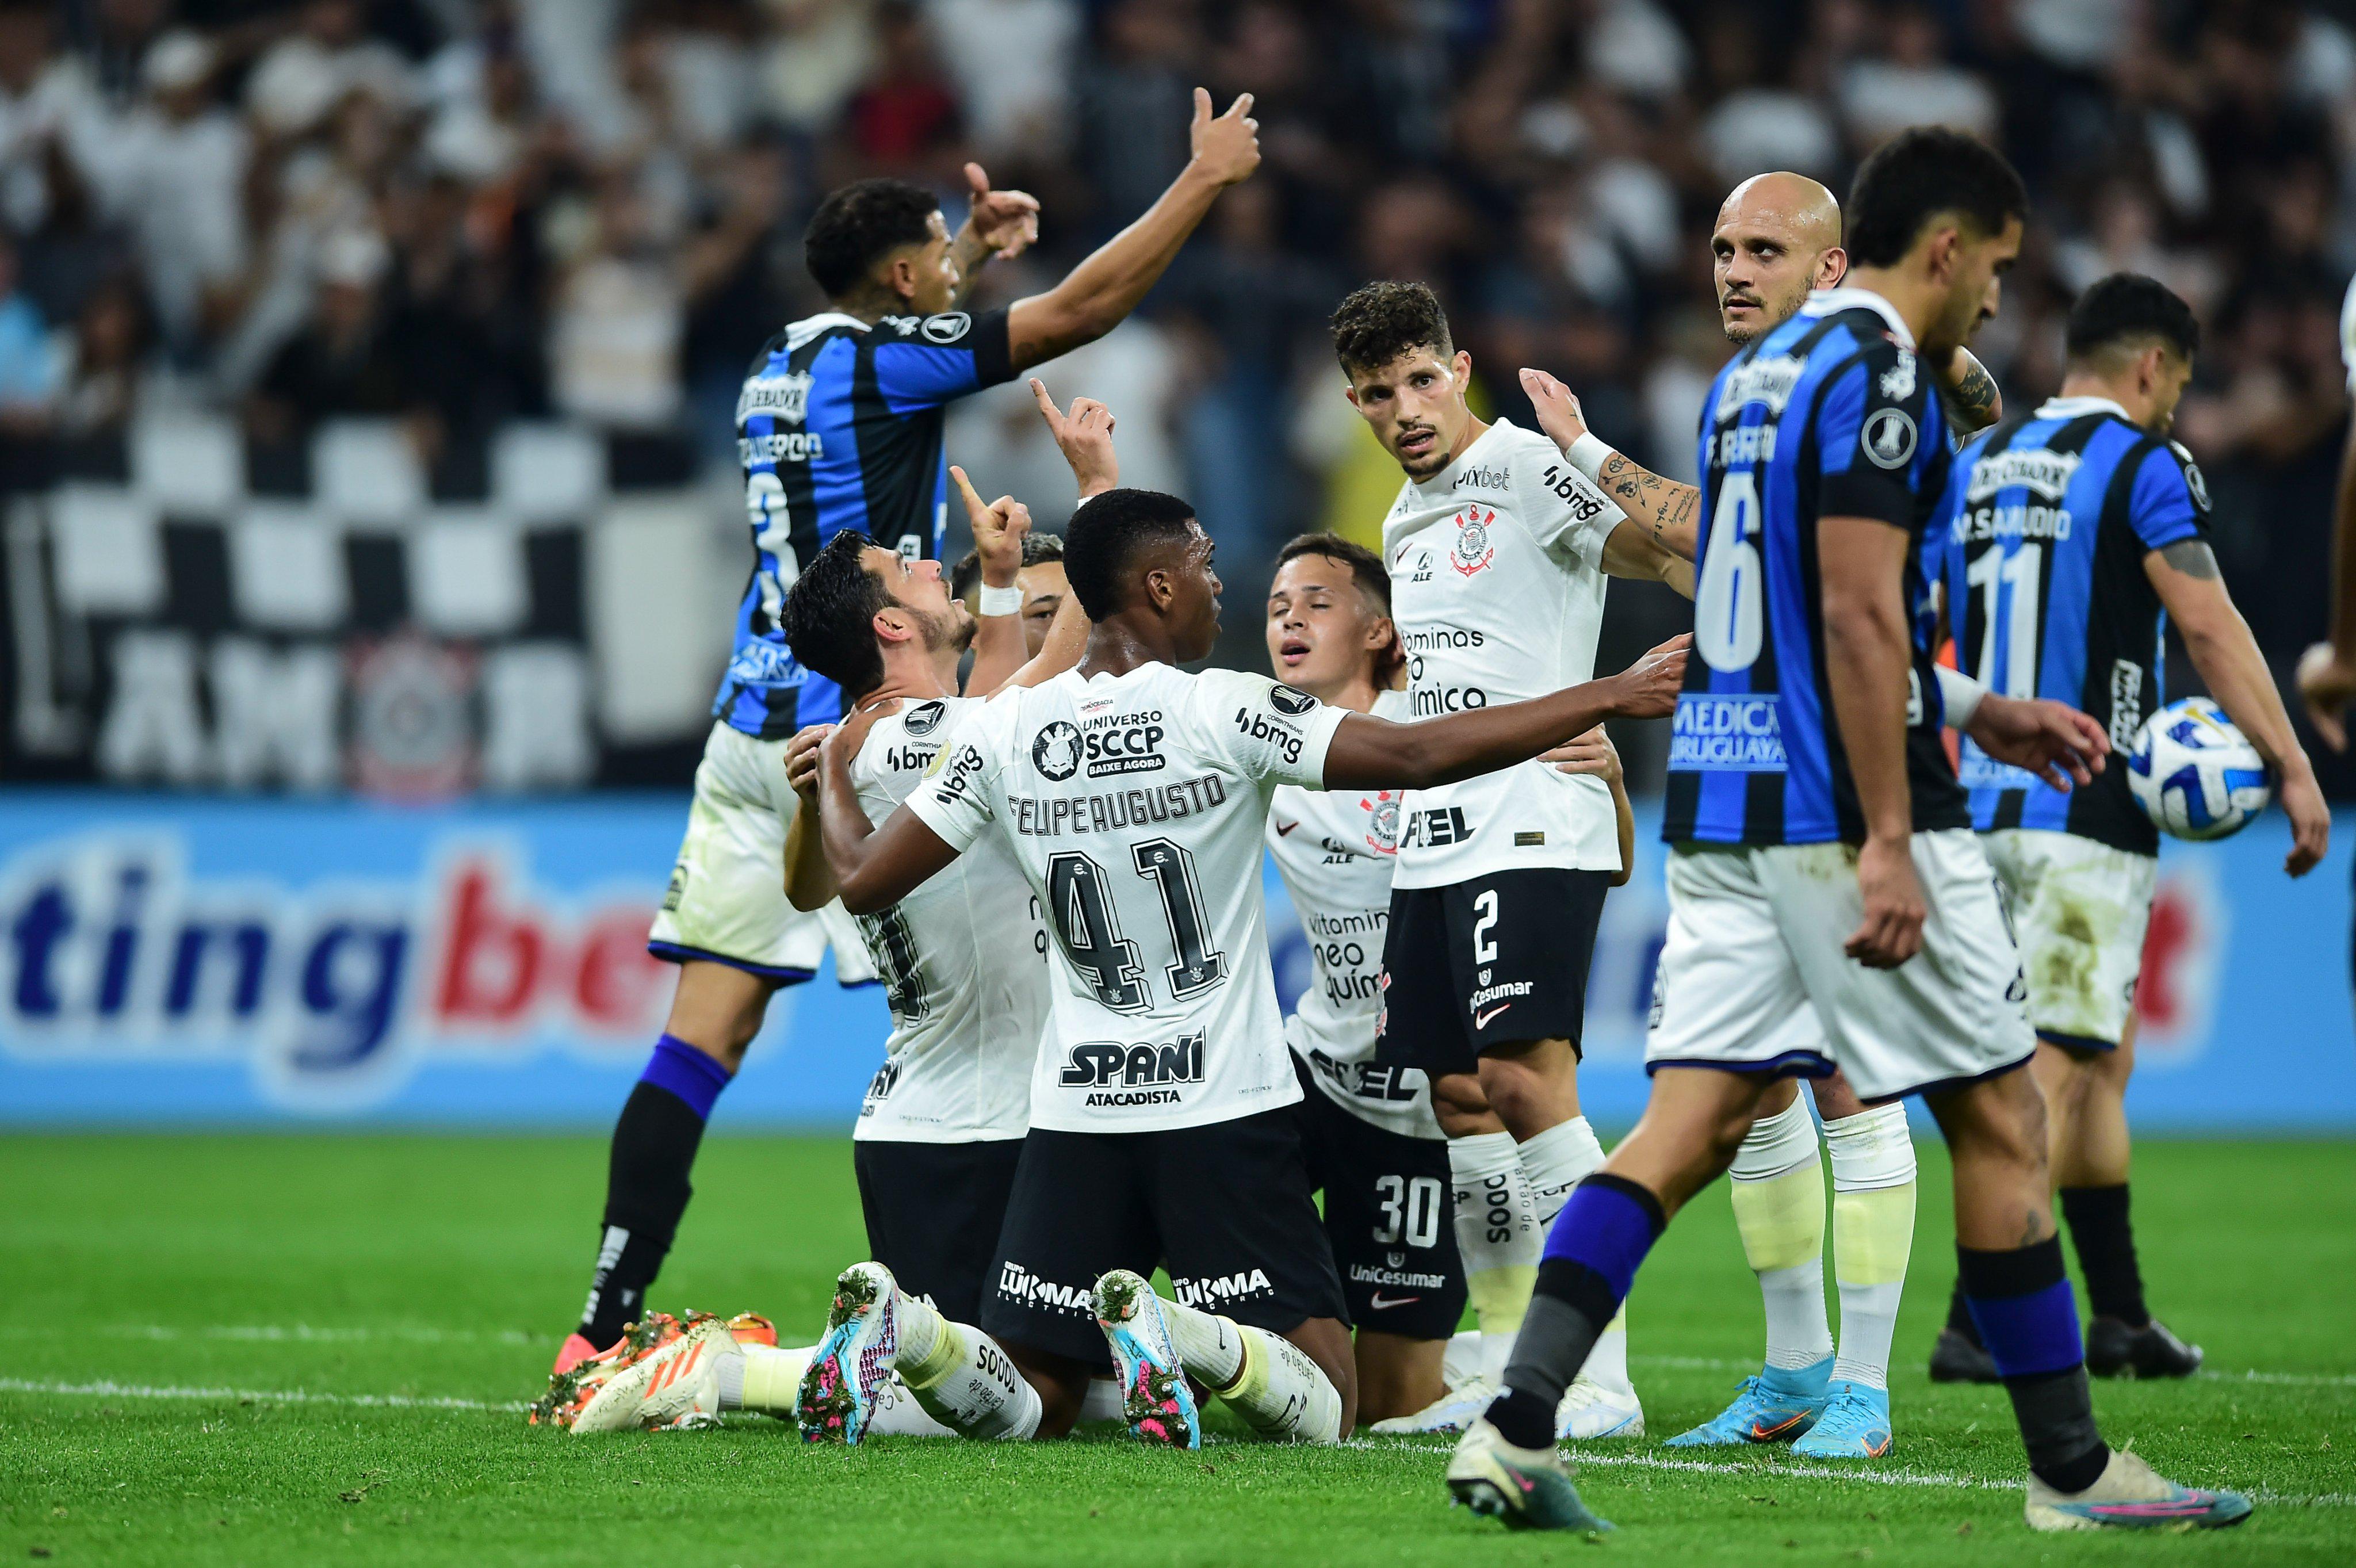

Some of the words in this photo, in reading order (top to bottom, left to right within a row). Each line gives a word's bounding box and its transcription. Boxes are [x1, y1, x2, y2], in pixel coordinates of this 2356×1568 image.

[1554, 476, 1602, 521] bmg
[1411, 572, 1433, 583] ALE
[1695, 472, 1764, 673] 6
[1967, 542, 2043, 701] 11
[1083, 710, 1163, 731] UNIVERSO
[1250, 713, 1303, 764] bmg
[1267, 714, 1304, 736] CORINTHIANS
[1086, 726, 1164, 760] SCCP
[943, 745, 984, 793] bmg
[1089, 762, 1122, 775] BAIXE
[1123, 758, 1162, 771] AGORA
[1322, 854, 1354, 864] ALE
[1045, 836, 1230, 1016] 41
[1474, 889, 1498, 965] 2
[1085, 1089, 1181, 1106] ATACADISTA
[1372, 1175, 1442, 1248] 30
[1349, 1265, 1445, 1288] UniCesumar
